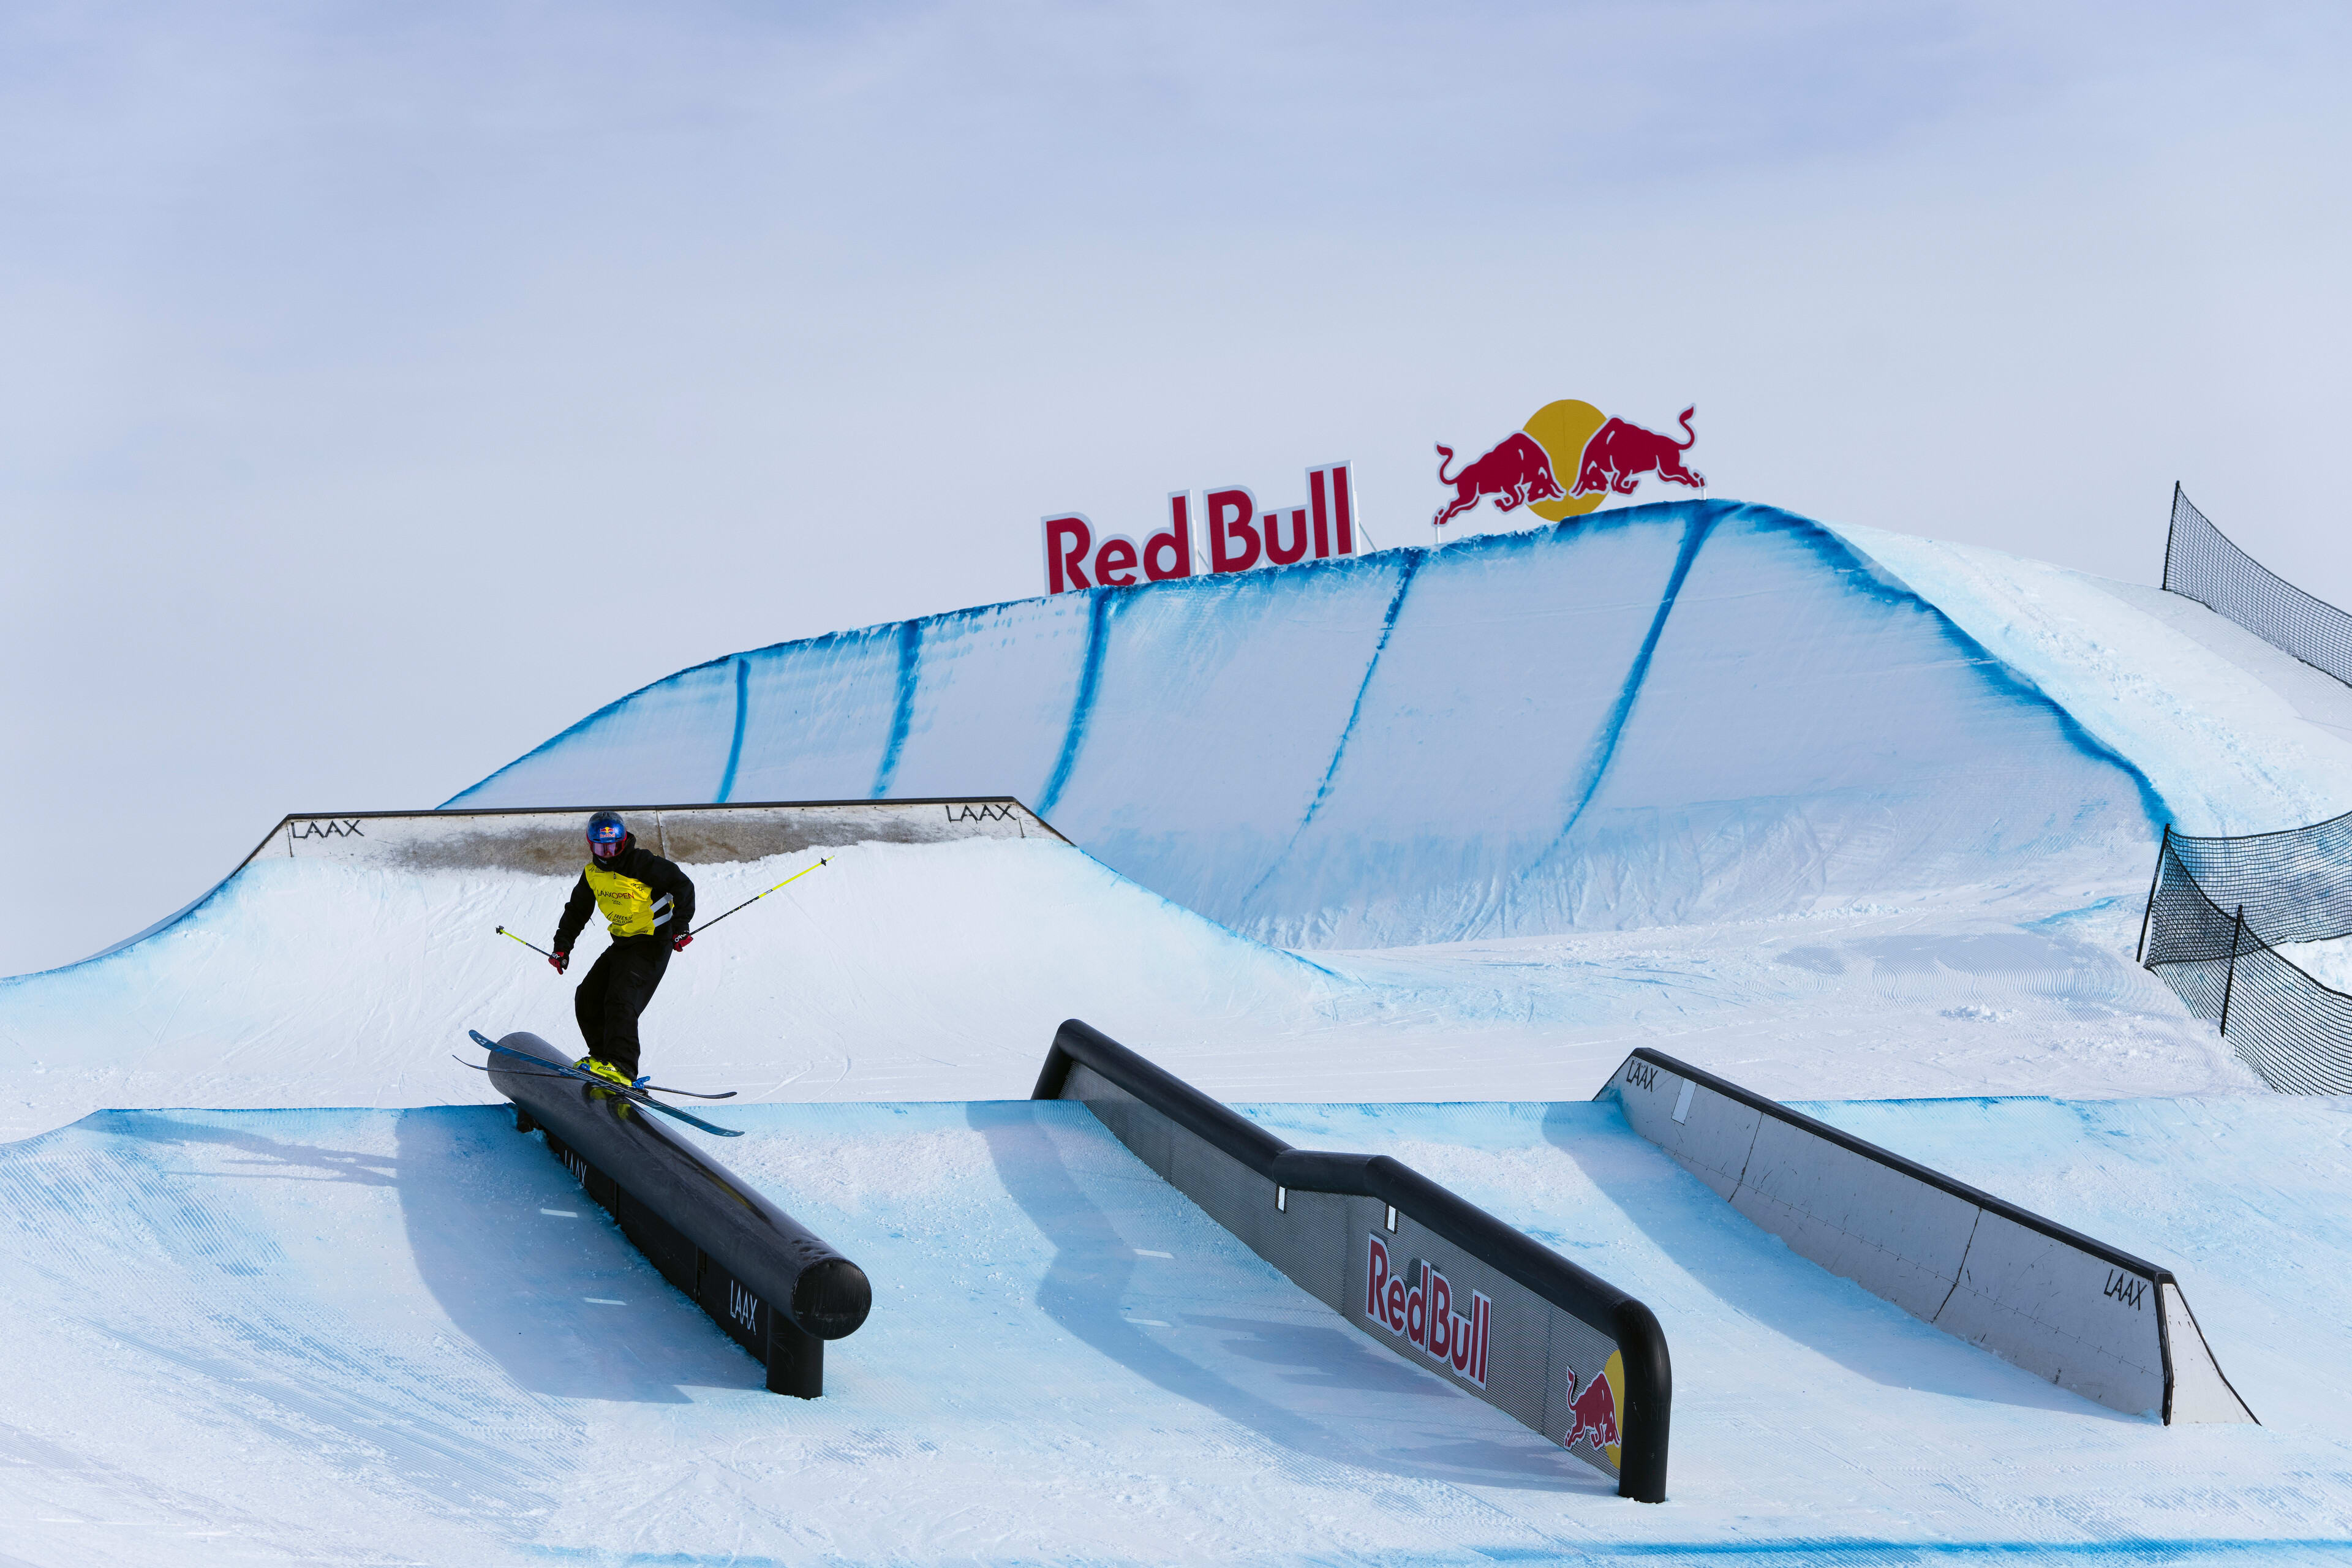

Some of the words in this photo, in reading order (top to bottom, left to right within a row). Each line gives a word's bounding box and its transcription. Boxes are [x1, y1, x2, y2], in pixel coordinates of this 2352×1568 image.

[1046, 495, 1193, 595] Red
[1207, 466, 1352, 574] Bull
[291, 820, 364, 839] LAAX
[945, 804, 1017, 822] LAAX
[1626, 1060, 1657, 1092] LAAX
[730, 1279, 758, 1336] LAAX
[1368, 1238, 1428, 1346] Red
[1429, 1274, 1489, 1384] Bull
[2103, 1268, 2147, 1311] LAAX
